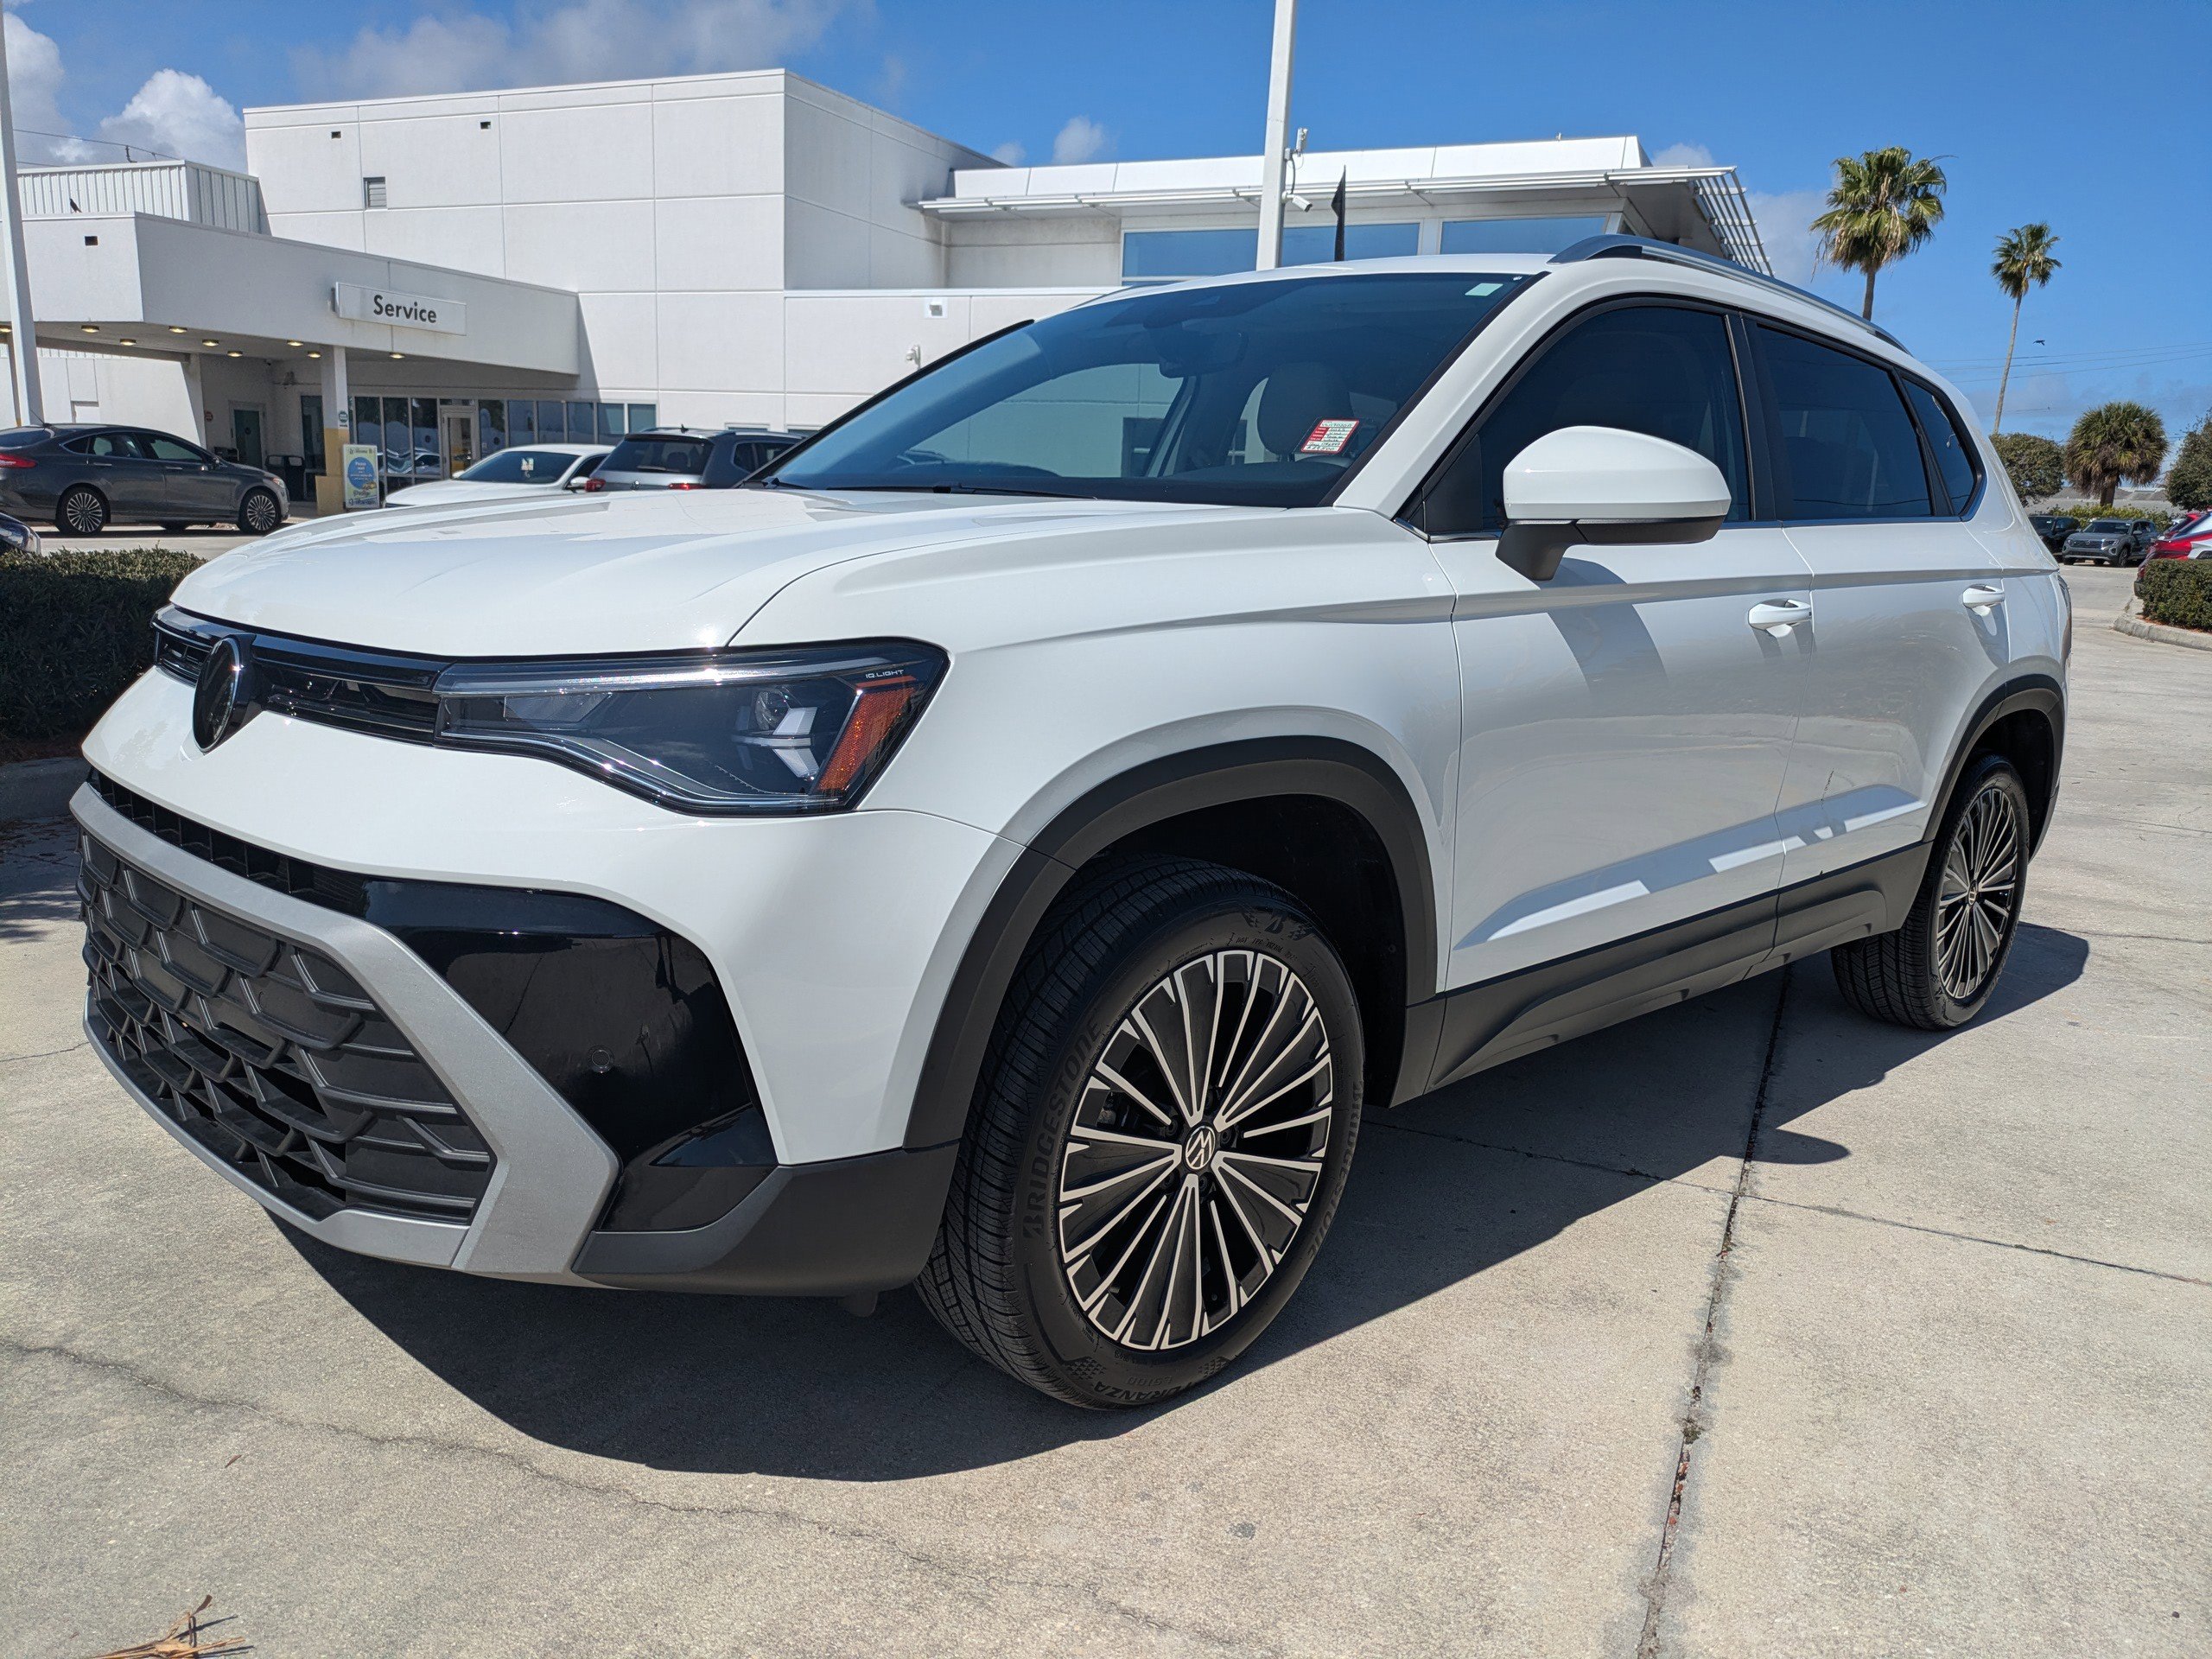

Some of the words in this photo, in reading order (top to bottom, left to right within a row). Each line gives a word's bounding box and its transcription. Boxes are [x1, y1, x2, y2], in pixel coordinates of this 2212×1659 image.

[373, 294, 437, 324] Service
[865, 669, 905, 679] IQ.LIGHT
[1022, 1018, 1103, 1239] BRIDGESTONE
